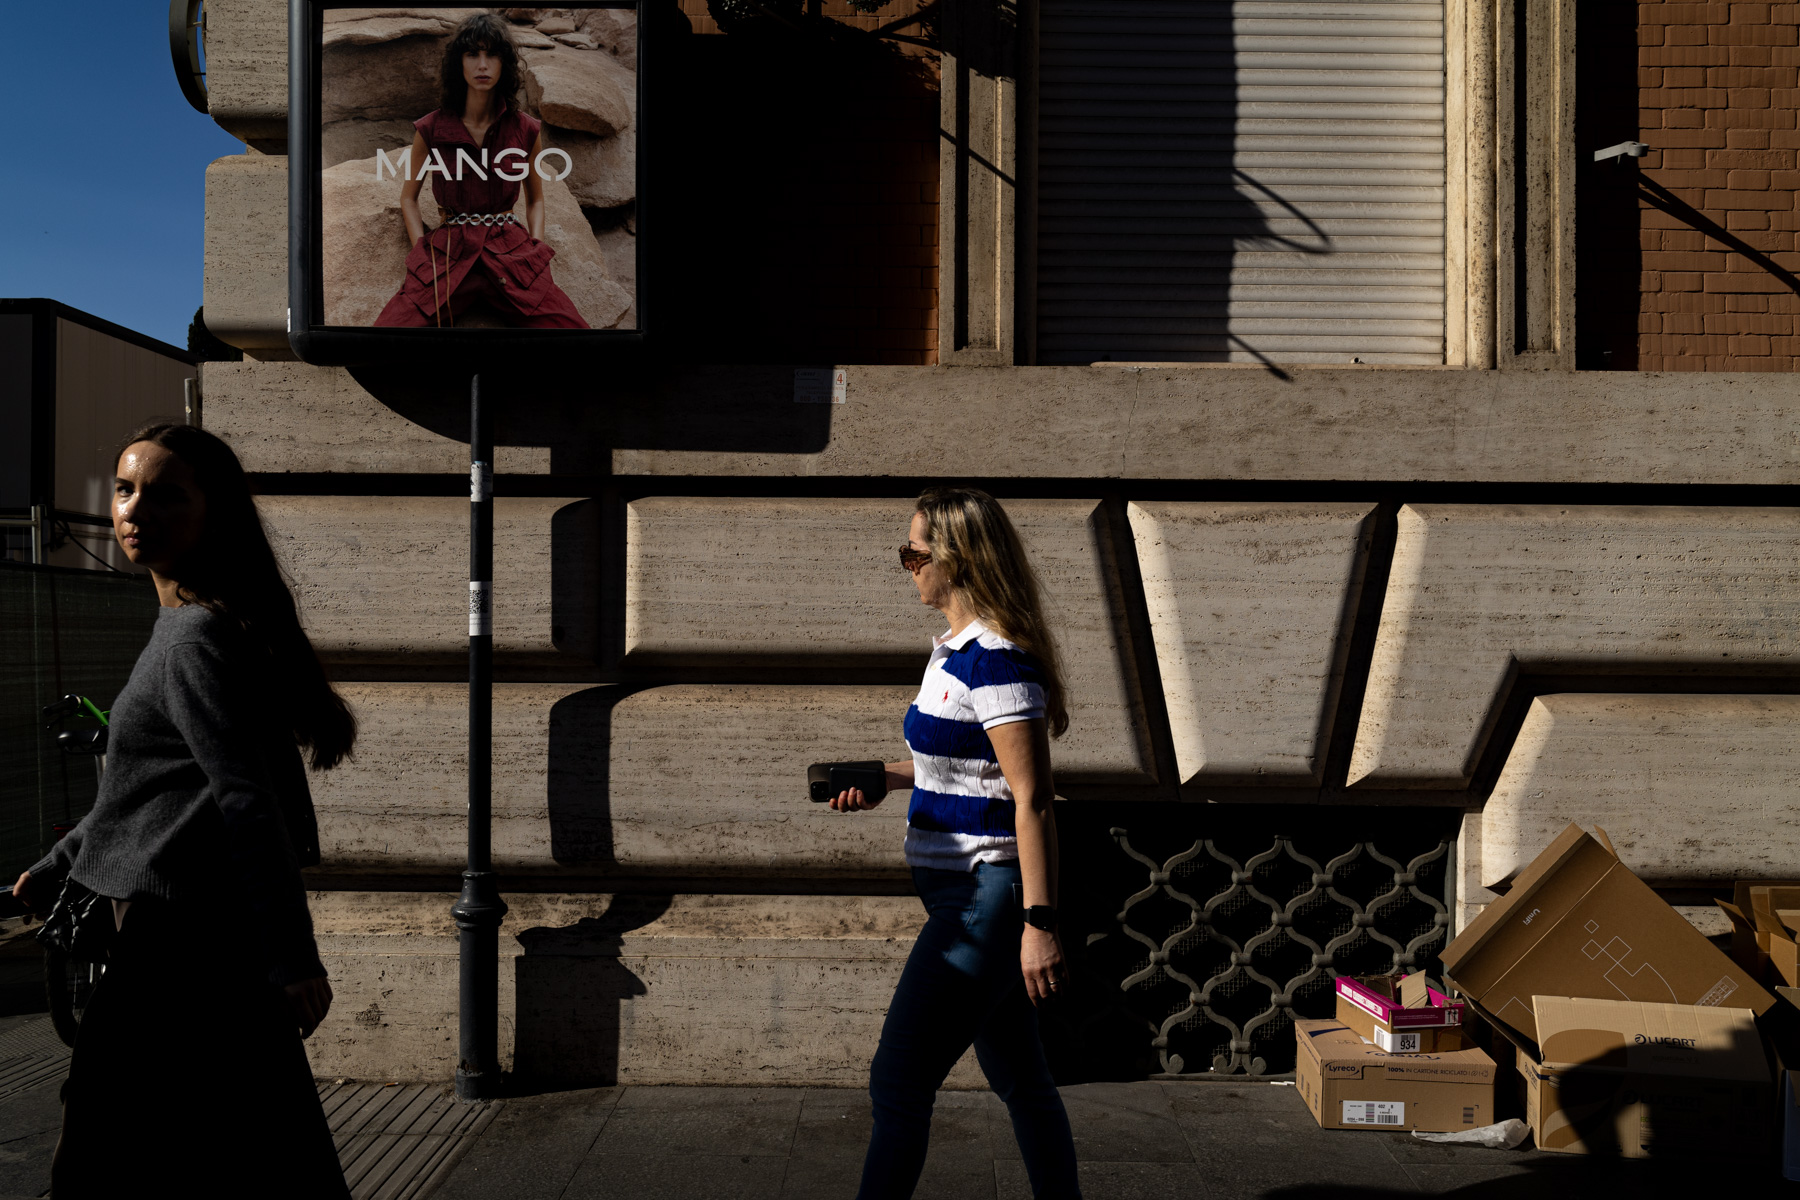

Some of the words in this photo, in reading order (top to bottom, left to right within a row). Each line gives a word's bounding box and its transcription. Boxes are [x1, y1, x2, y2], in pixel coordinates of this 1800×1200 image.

[376, 147, 573, 182] MANGO
[837, 373, 843, 384] 4
[1522, 907, 1541, 926] UniFi
[1400, 1040, 1416, 1050] 934
[1648, 1036, 1696, 1047] LUCART
[1329, 1064, 1356, 1075] Lyreco
